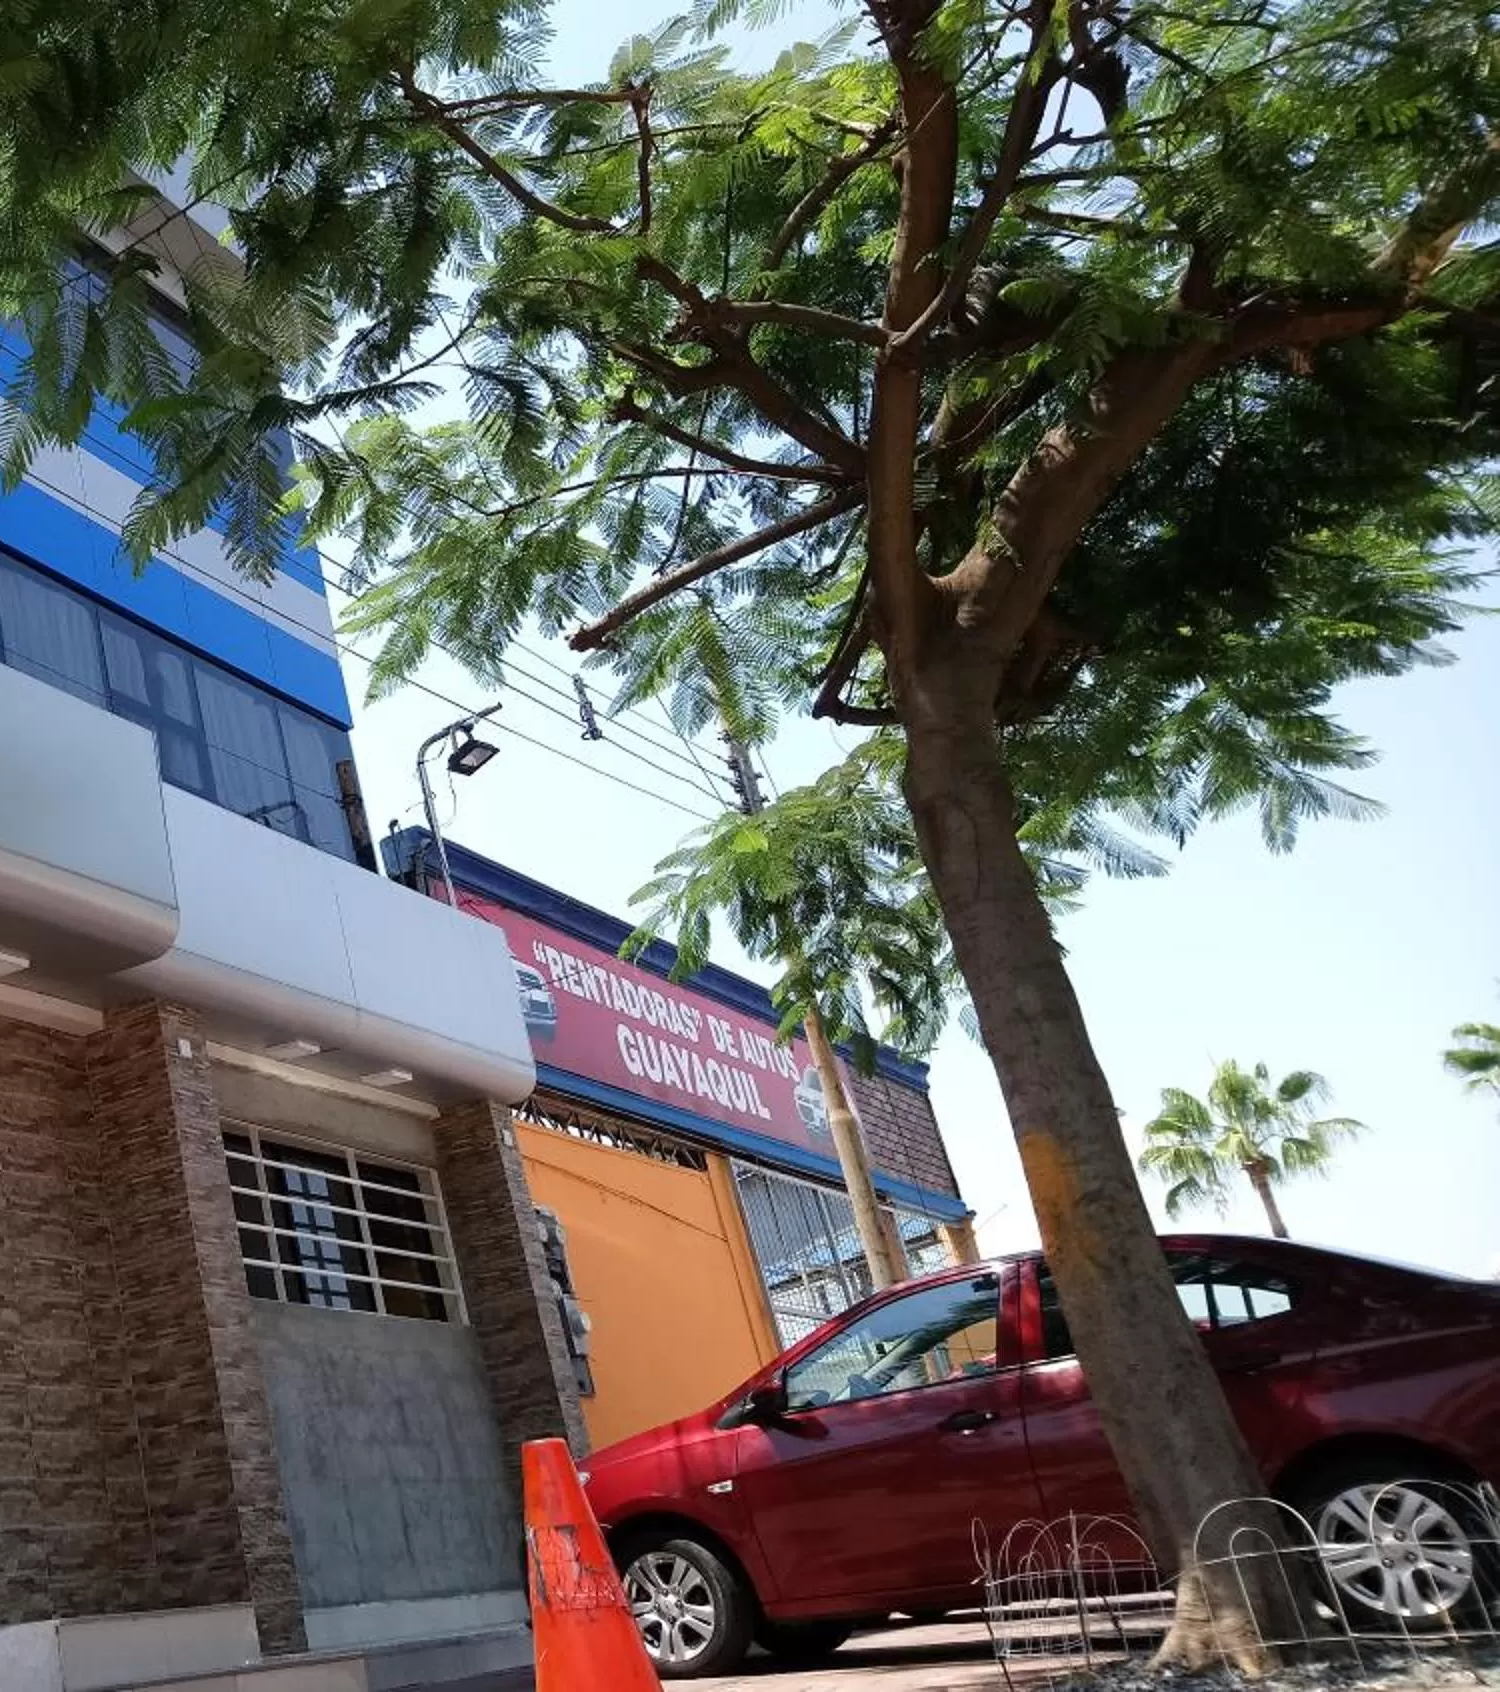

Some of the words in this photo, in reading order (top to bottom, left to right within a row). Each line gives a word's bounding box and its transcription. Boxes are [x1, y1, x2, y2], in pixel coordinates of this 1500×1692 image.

[617, 1023, 773, 1121] GUAYAQUIL
[706, 1013, 741, 1059] DE
[740, 1027, 801, 1083] AUTOS
